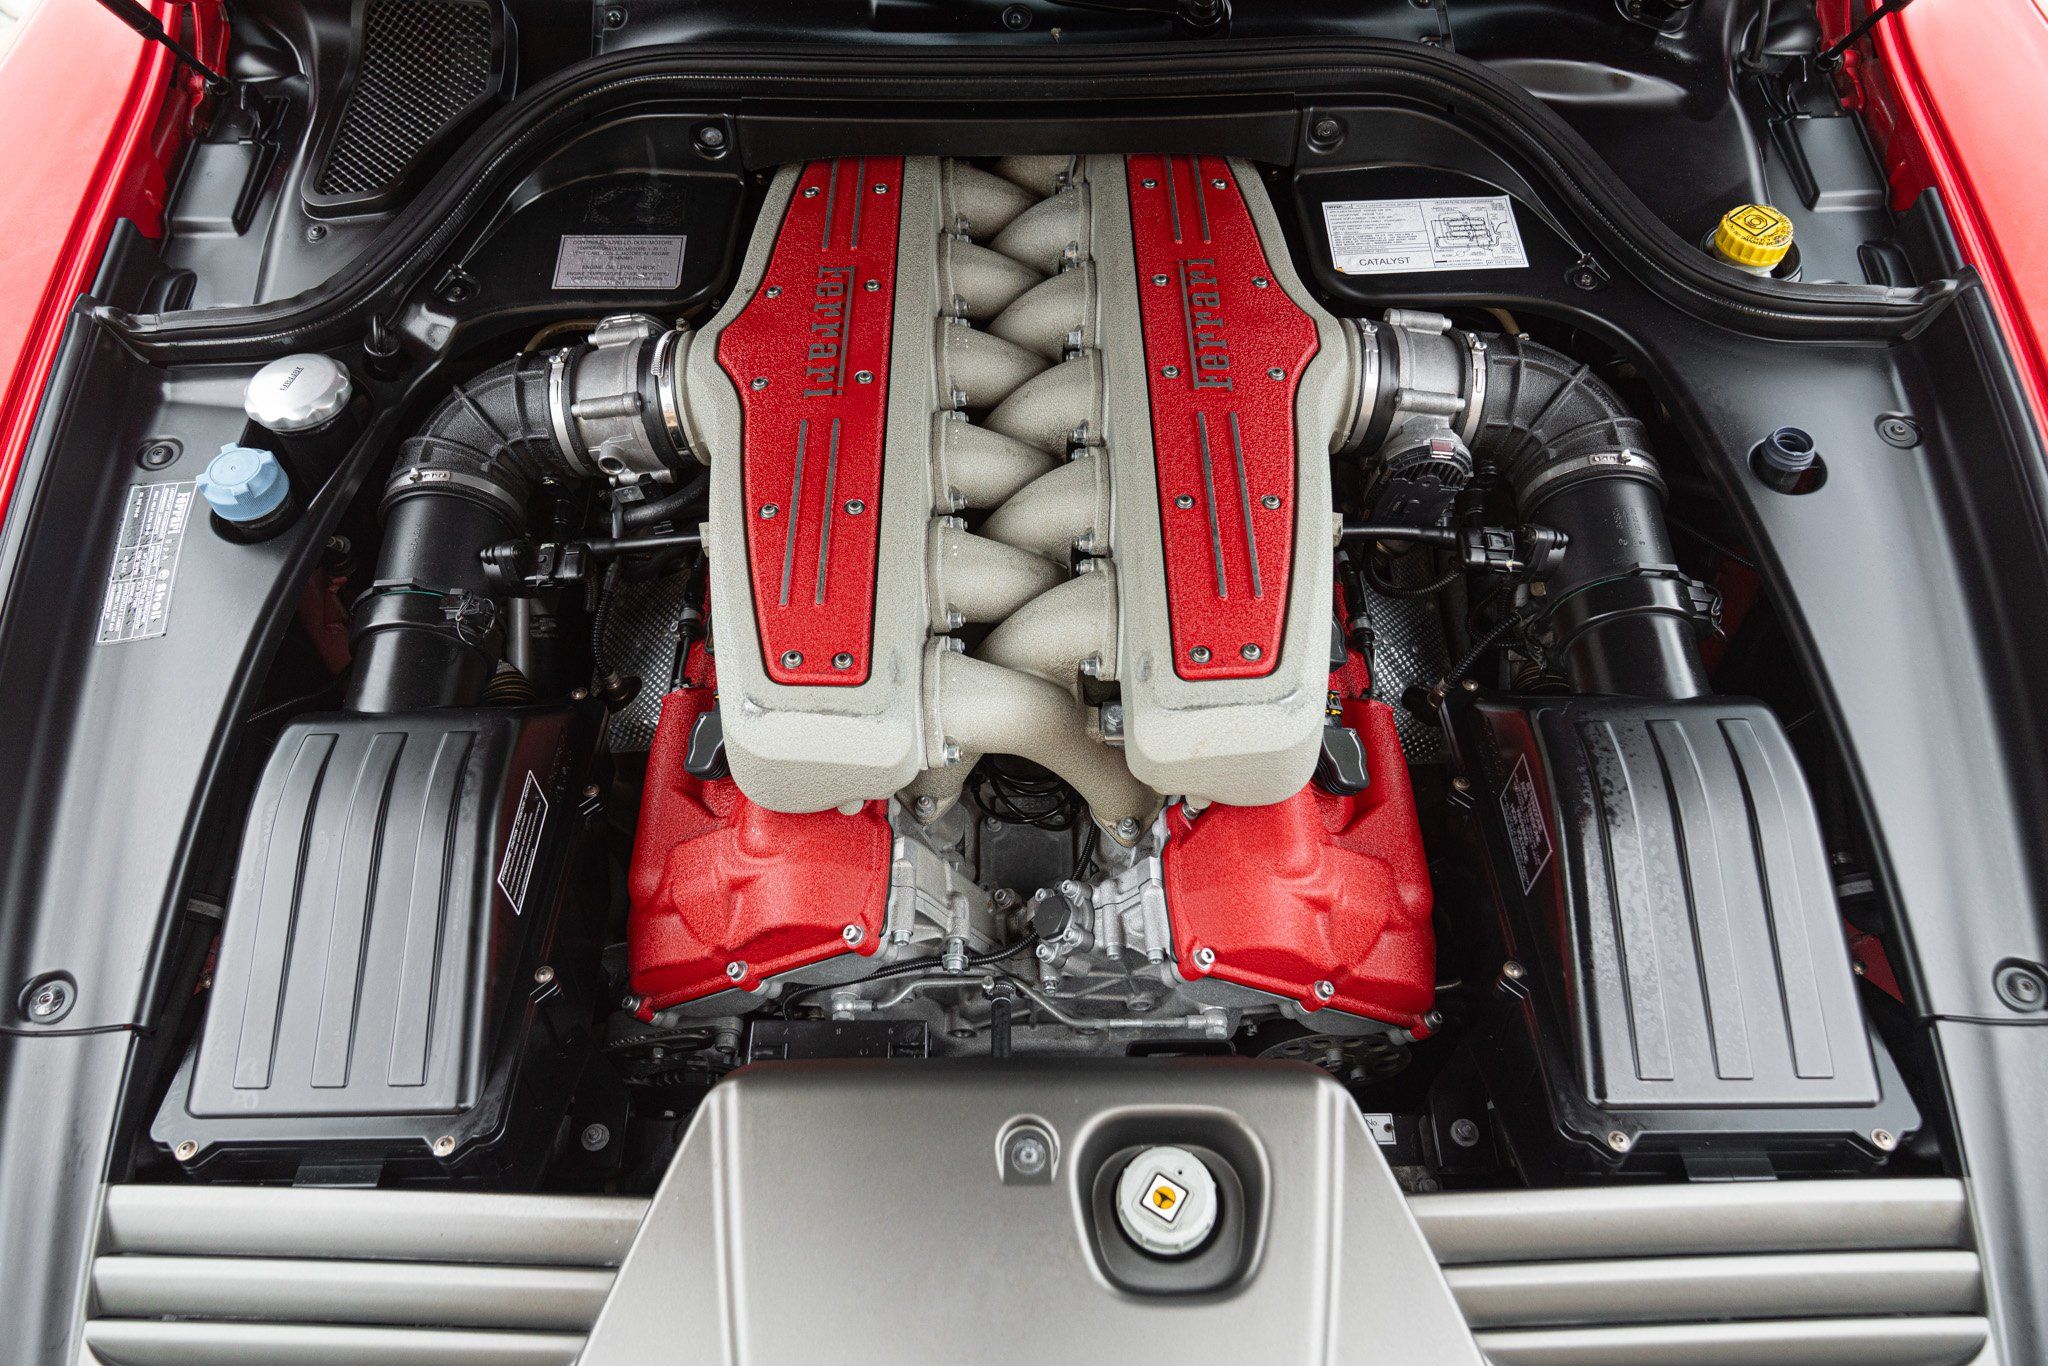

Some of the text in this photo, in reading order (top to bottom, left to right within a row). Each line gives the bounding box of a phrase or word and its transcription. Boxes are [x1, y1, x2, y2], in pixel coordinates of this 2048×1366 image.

[1359, 256, 1411, 266] CATALYST
[803, 265, 855, 399] Ferrari
[1179, 258, 1233, 391] Ferrari
[168, 492, 190, 535] Ferrari
[150, 582, 168, 620] Shell
